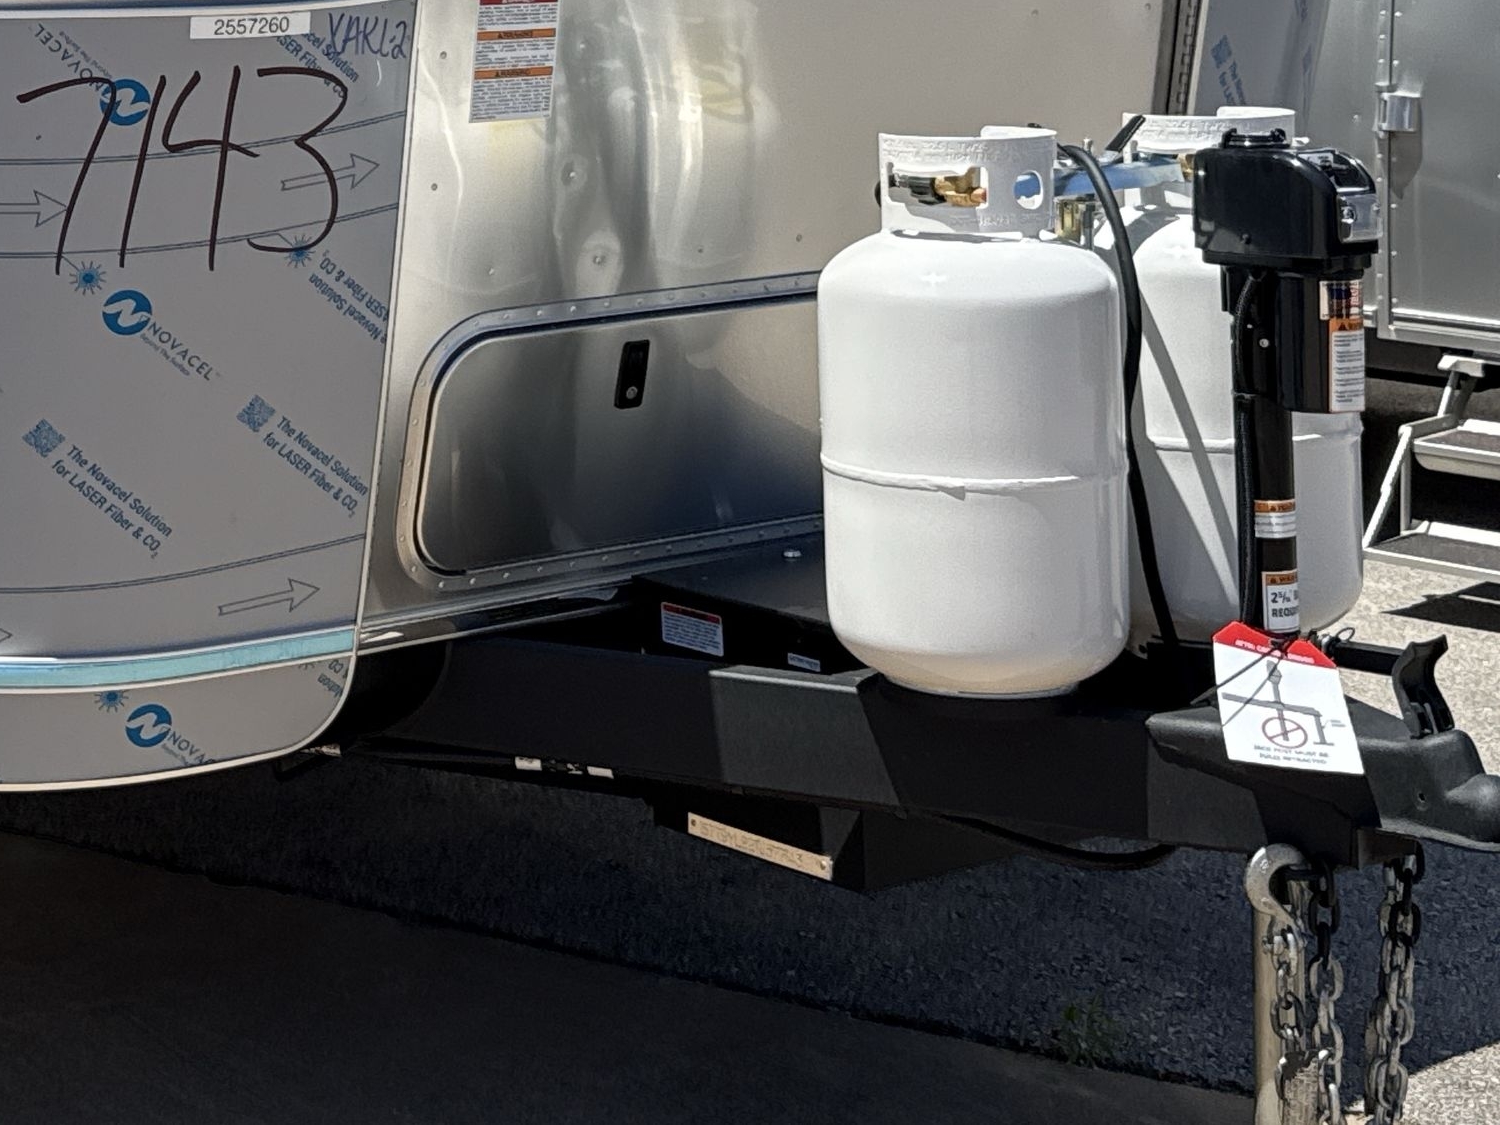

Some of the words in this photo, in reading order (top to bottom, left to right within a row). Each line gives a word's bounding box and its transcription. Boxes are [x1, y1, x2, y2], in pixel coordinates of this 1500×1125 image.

[213, 17, 290, 36] 2557260
[322, 43, 360, 83] Solution
[17, 65, 348, 275] 7143
[309, 273, 348, 311] Solution
[334, 269, 345, 283] &
[343, 276, 368, 302] Fiber
[343, 304, 382, 341] Novacel
[147, 322, 213, 381] NOVACEL
[263, 432, 280, 450] for
[278, 443, 312, 475] LASER
[308, 468, 335, 493] Fiber
[332, 487, 343, 501] &
[277, 415, 296, 437] The
[294, 431, 334, 467] Novacel
[330, 460, 369, 496] Solution
[51, 459, 71, 478] for
[68, 473, 107, 509] LASER
[104, 503, 134, 530] Fiber
[132, 526, 144, 539] &
[67, 444, 88, 468] The
[87, 463, 133, 503] Novacel
[129, 498, 173, 537] Solution
